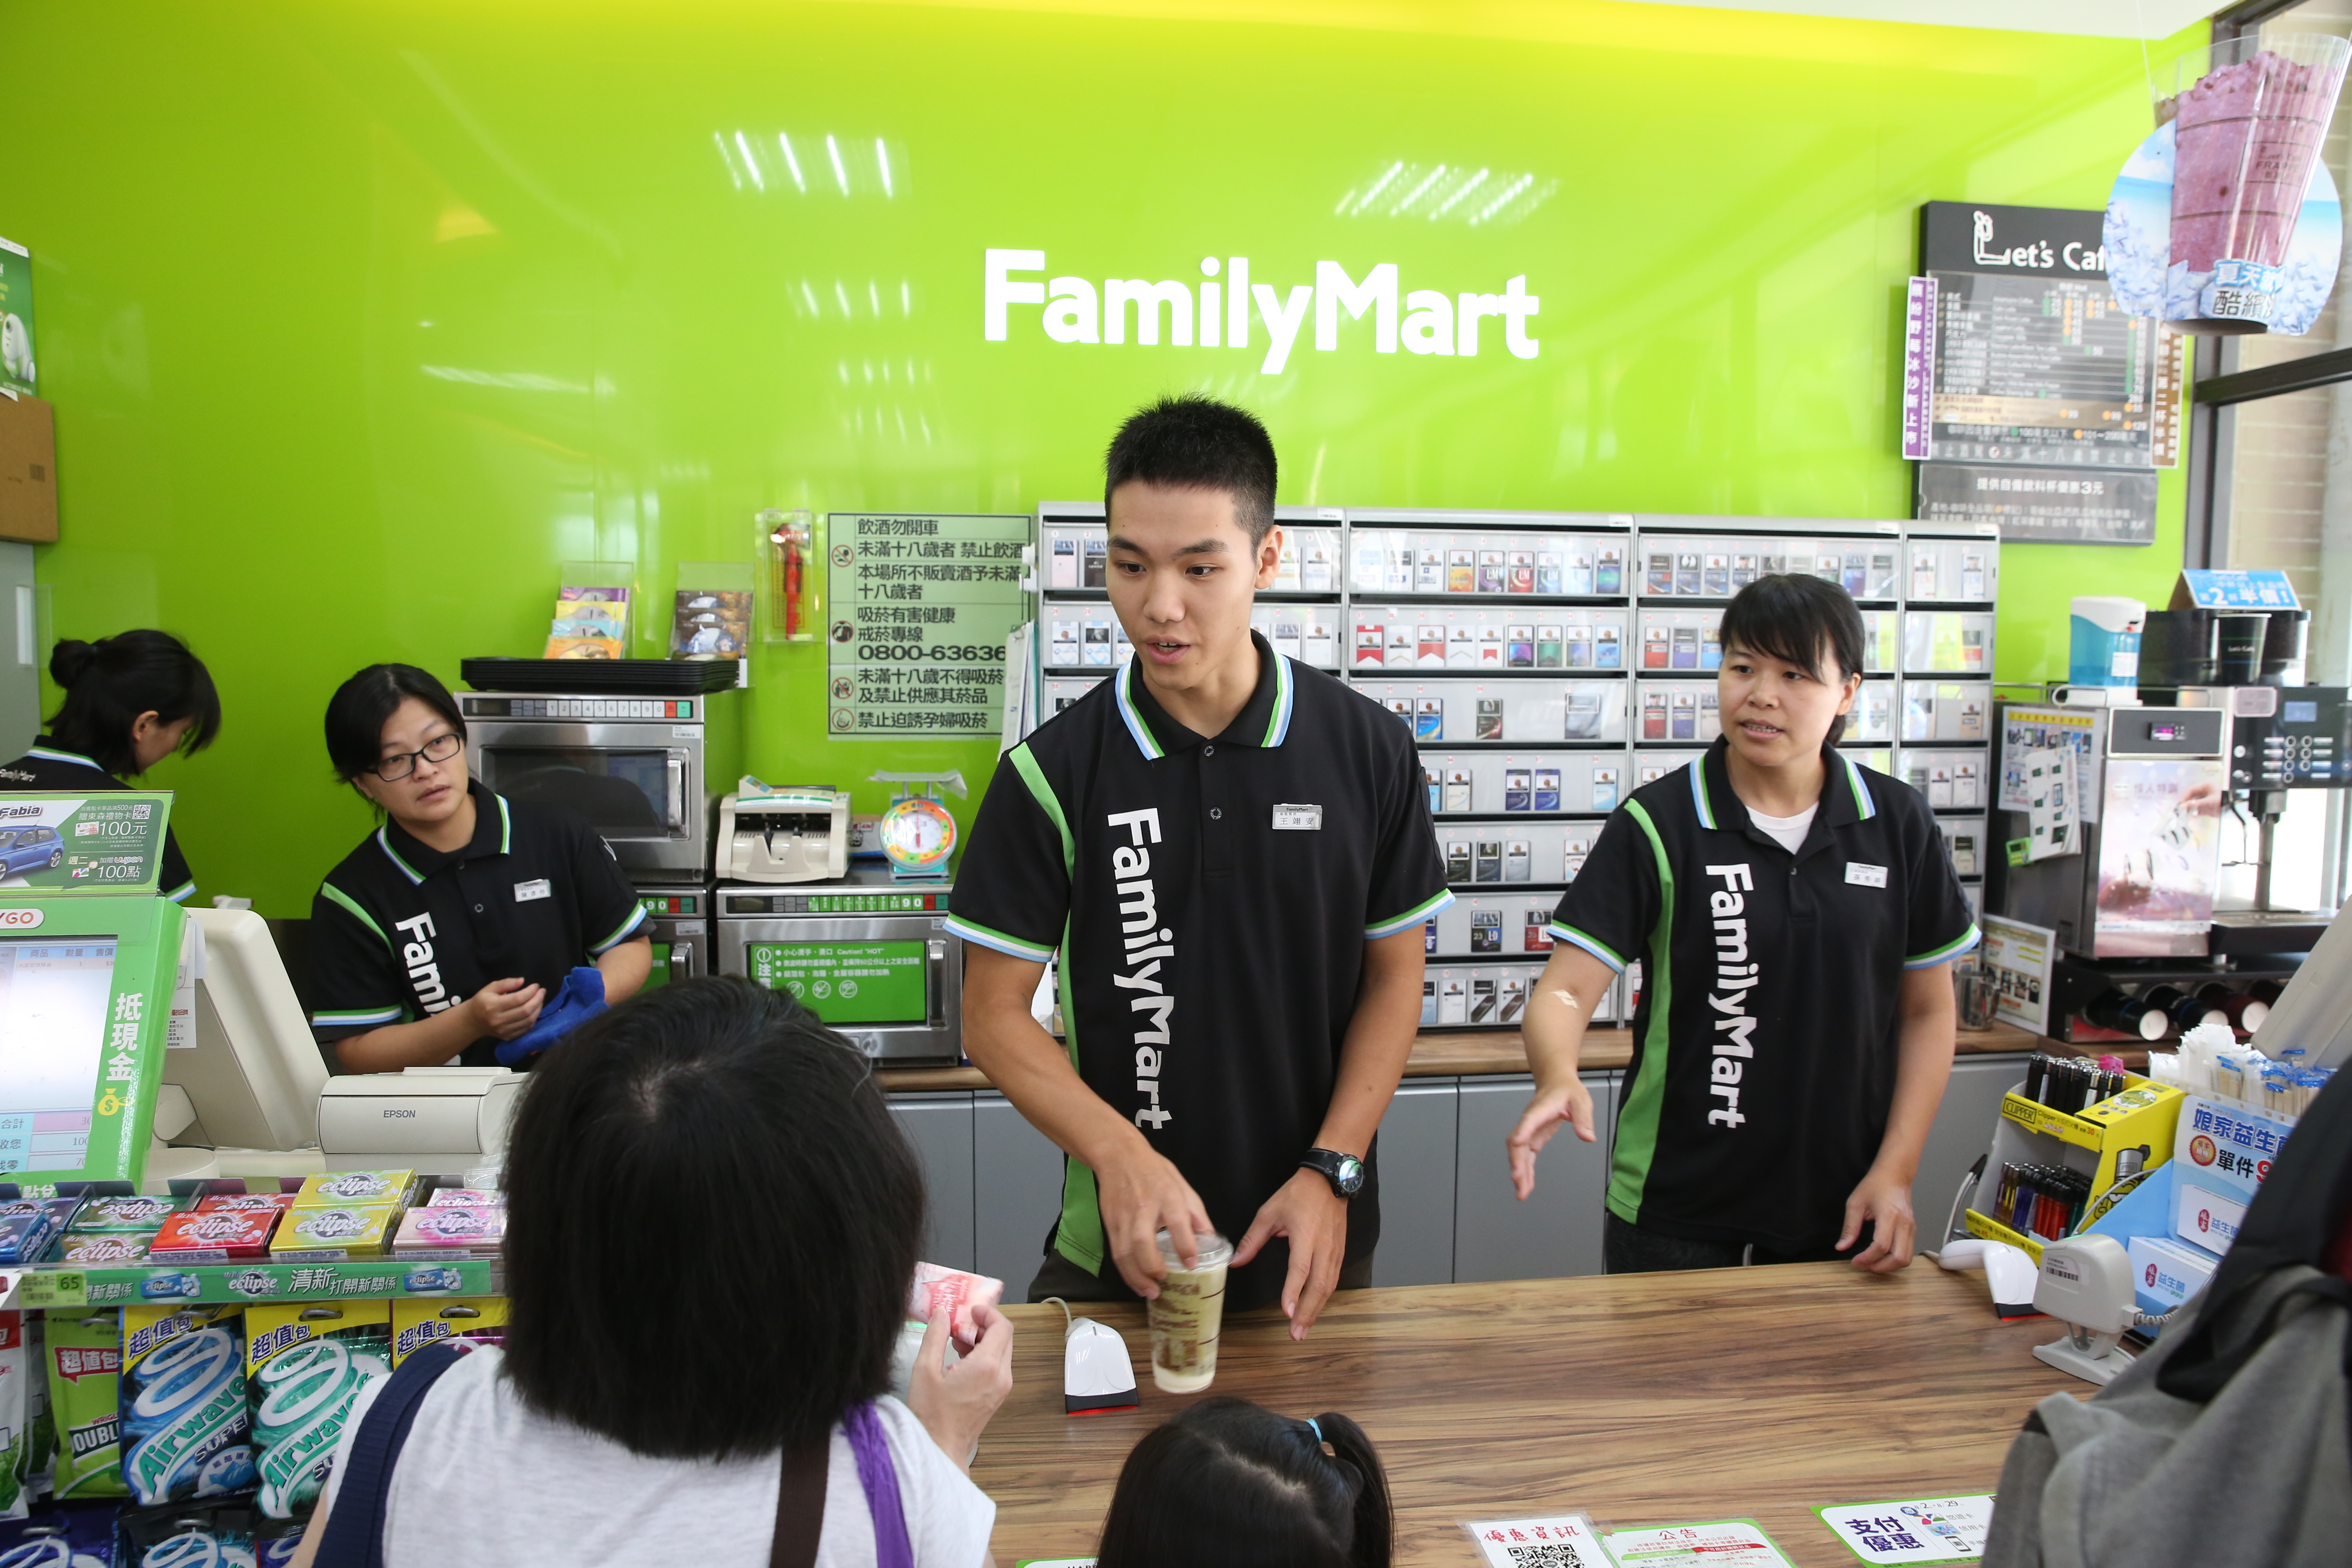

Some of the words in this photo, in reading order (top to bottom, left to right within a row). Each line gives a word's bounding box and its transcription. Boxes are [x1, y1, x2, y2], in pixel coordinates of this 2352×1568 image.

[1973, 210, 2054, 266] Let's
[2062, 242, 2105, 272] Caf
[984, 248, 1539, 374] FamilyMart
[858, 519, 939, 536] 飲酒勿開車
[858, 541, 956, 558] 未滿十八歲者
[960, 542, 1023, 559] 禁止飲酒
[858, 565, 1021, 582] 本場所不販賣酒予未滿
[858, 584, 923, 600] 十八歲者
[858, 607, 956, 624] 吸菸有害健康
[858, 627, 923, 643] 戒菸專線
[858, 645, 1006, 661] 0800-63636
[858, 668, 1004, 685] 未滿十八歲不得吸菸
[858, 688, 988, 704] 及禁止供應其菸品
[858, 712, 988, 729] 禁止迫誘孕婦吸菸
[0, 806, 42, 817] Fabia
[99, 821, 147, 836] 100元
[68, 856, 88, 865] 週二
[98, 865, 141, 878] 100點
[902, 898, 910, 907] 9
[914, 898, 922, 907] 0
[65, 949, 83, 957] 數量
[96, 948, 114, 956] 售價
[1107, 808, 1175, 1129] FamilyMart
[1706, 863, 1759, 1129] FamilyMart
[106, 992, 143, 1080] 抵現金
[383, 1109, 416, 1118] EPSON
[2005, 1102, 2034, 1121] CLIPPER
[1, 1118, 25, 1129] 合計
[2087, 1127, 2095, 1136] 30
[316, 1176, 391, 1197] eclipse
[176, 1218, 255, 1238] eclipse
[294, 1216, 371, 1236] eclipse
[416, 1214, 492, 1233] eclipse
[65, 1242, 145, 1261] eclipse
[61, 1276, 79, 1290] 65
[228, 1273, 278, 1293] eclipse
[288, 1267, 340, 1293] 清新
[330, 1276, 398, 1296] 打開新關係
[2158, 1272, 2186, 1293] 益生菌
[250, 1324, 311, 1365] 超值包
[396, 1320, 450, 1357] 超值包
[61, 1350, 118, 1373] 超值包
[70, 1423, 119, 1452] OUBL
[139, 1372, 246, 1494] Airwave
[194, 1413, 248, 1464] SUPE
[1484, 1525, 1580, 1543] 優惠資訊
[1659, 1528, 1698, 1541] 公告
[1844, 1516, 1905, 1535] 支付
[1862, 1532, 1925, 1552] 優惠
